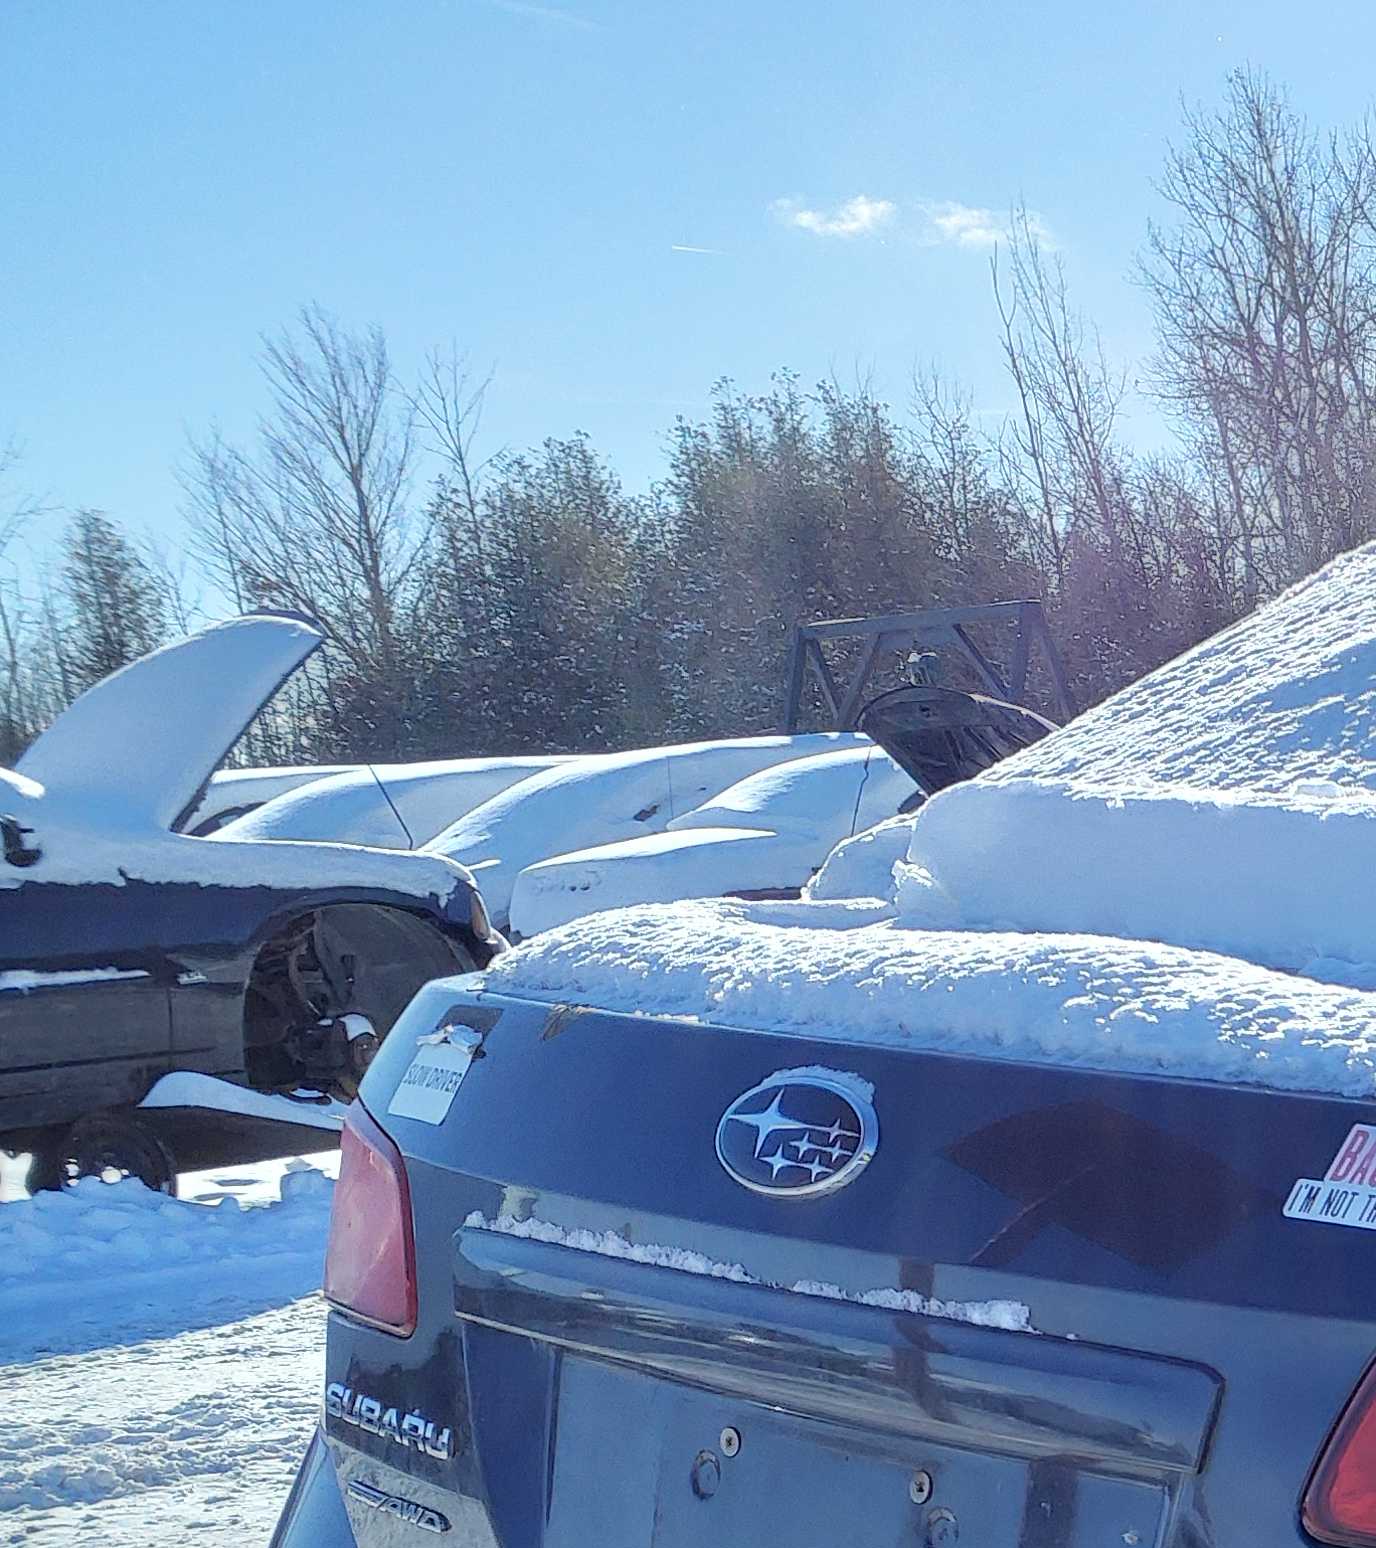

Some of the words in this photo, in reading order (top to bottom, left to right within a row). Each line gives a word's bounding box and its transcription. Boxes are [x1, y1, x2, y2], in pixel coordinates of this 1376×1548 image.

[426, 1066, 463, 1094] DRIVER
[1288, 1184, 1319, 1214] I'M
[1320, 1189, 1360, 1218] NOT
[327, 1382, 451, 1461] SUBARU
